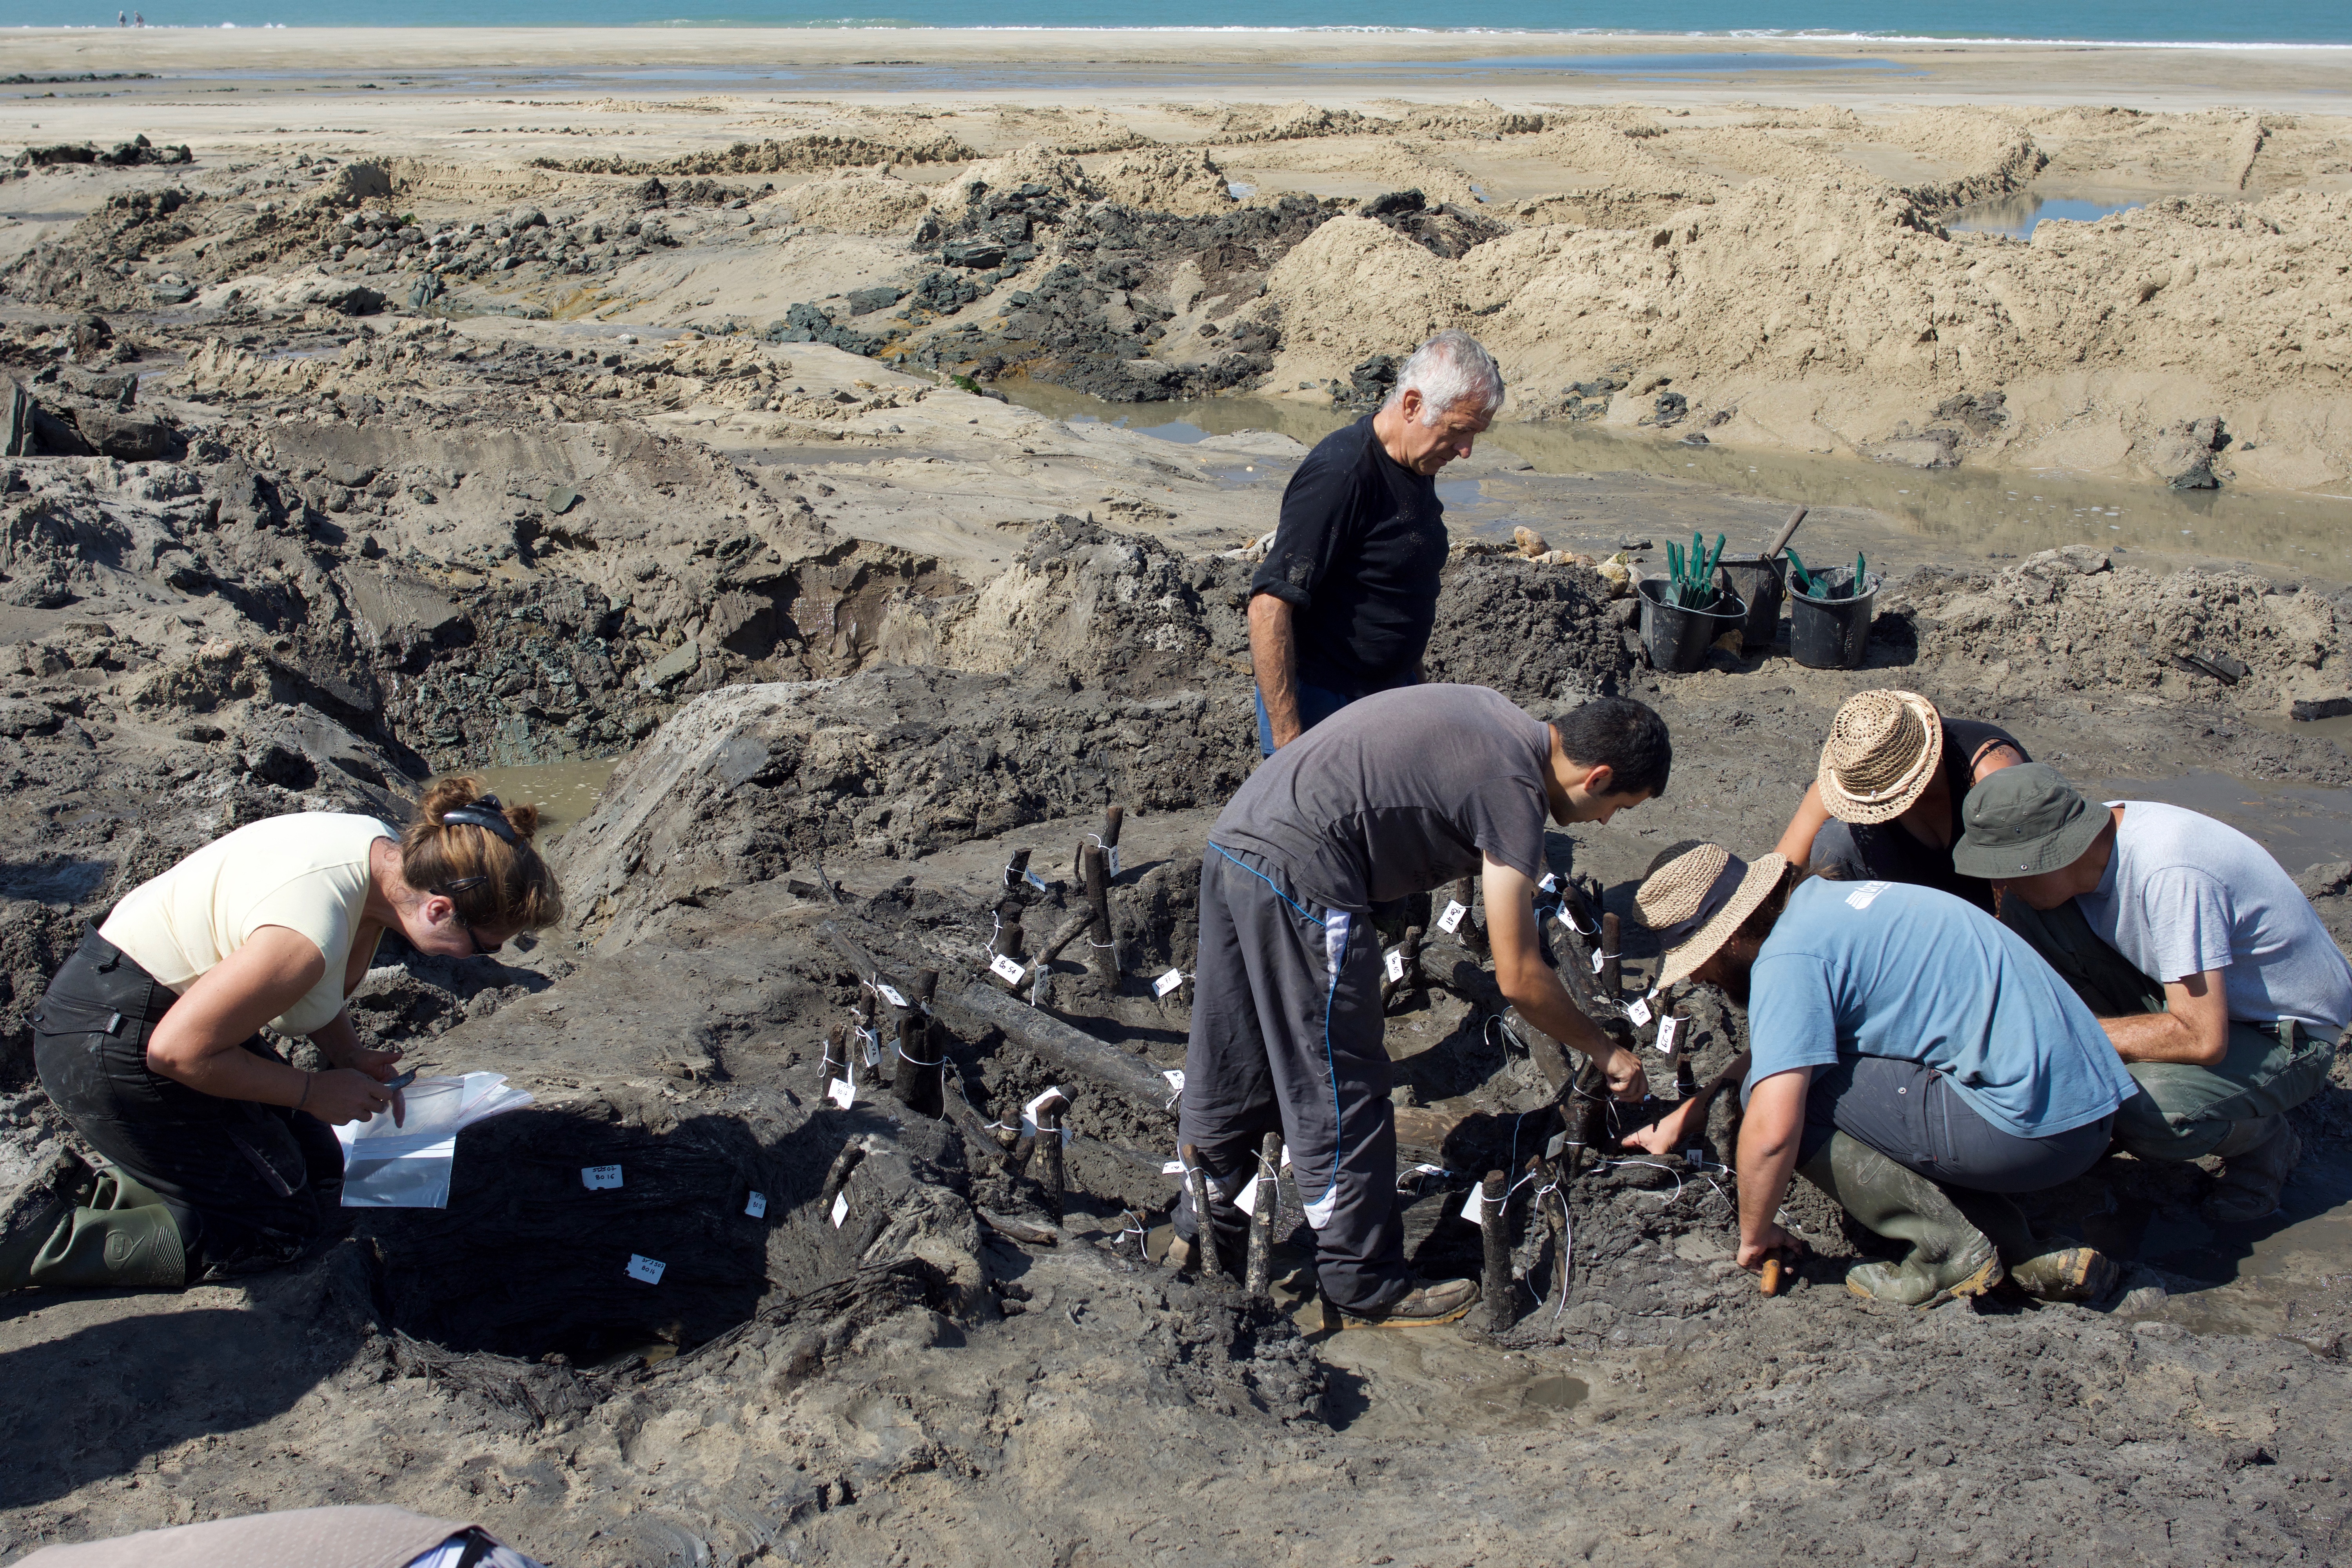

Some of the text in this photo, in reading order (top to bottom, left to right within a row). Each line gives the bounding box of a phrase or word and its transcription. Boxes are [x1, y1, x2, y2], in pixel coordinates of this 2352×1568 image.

[1113, 860, 1118, 868] 38
[1446, 917, 1454, 926] 47
[999, 960, 1005, 969] Bo
[1040, 971, 1045, 979] Bo
[1661, 1025, 1672, 1047] Bo 29
[872, 1046, 876, 1057] 72
